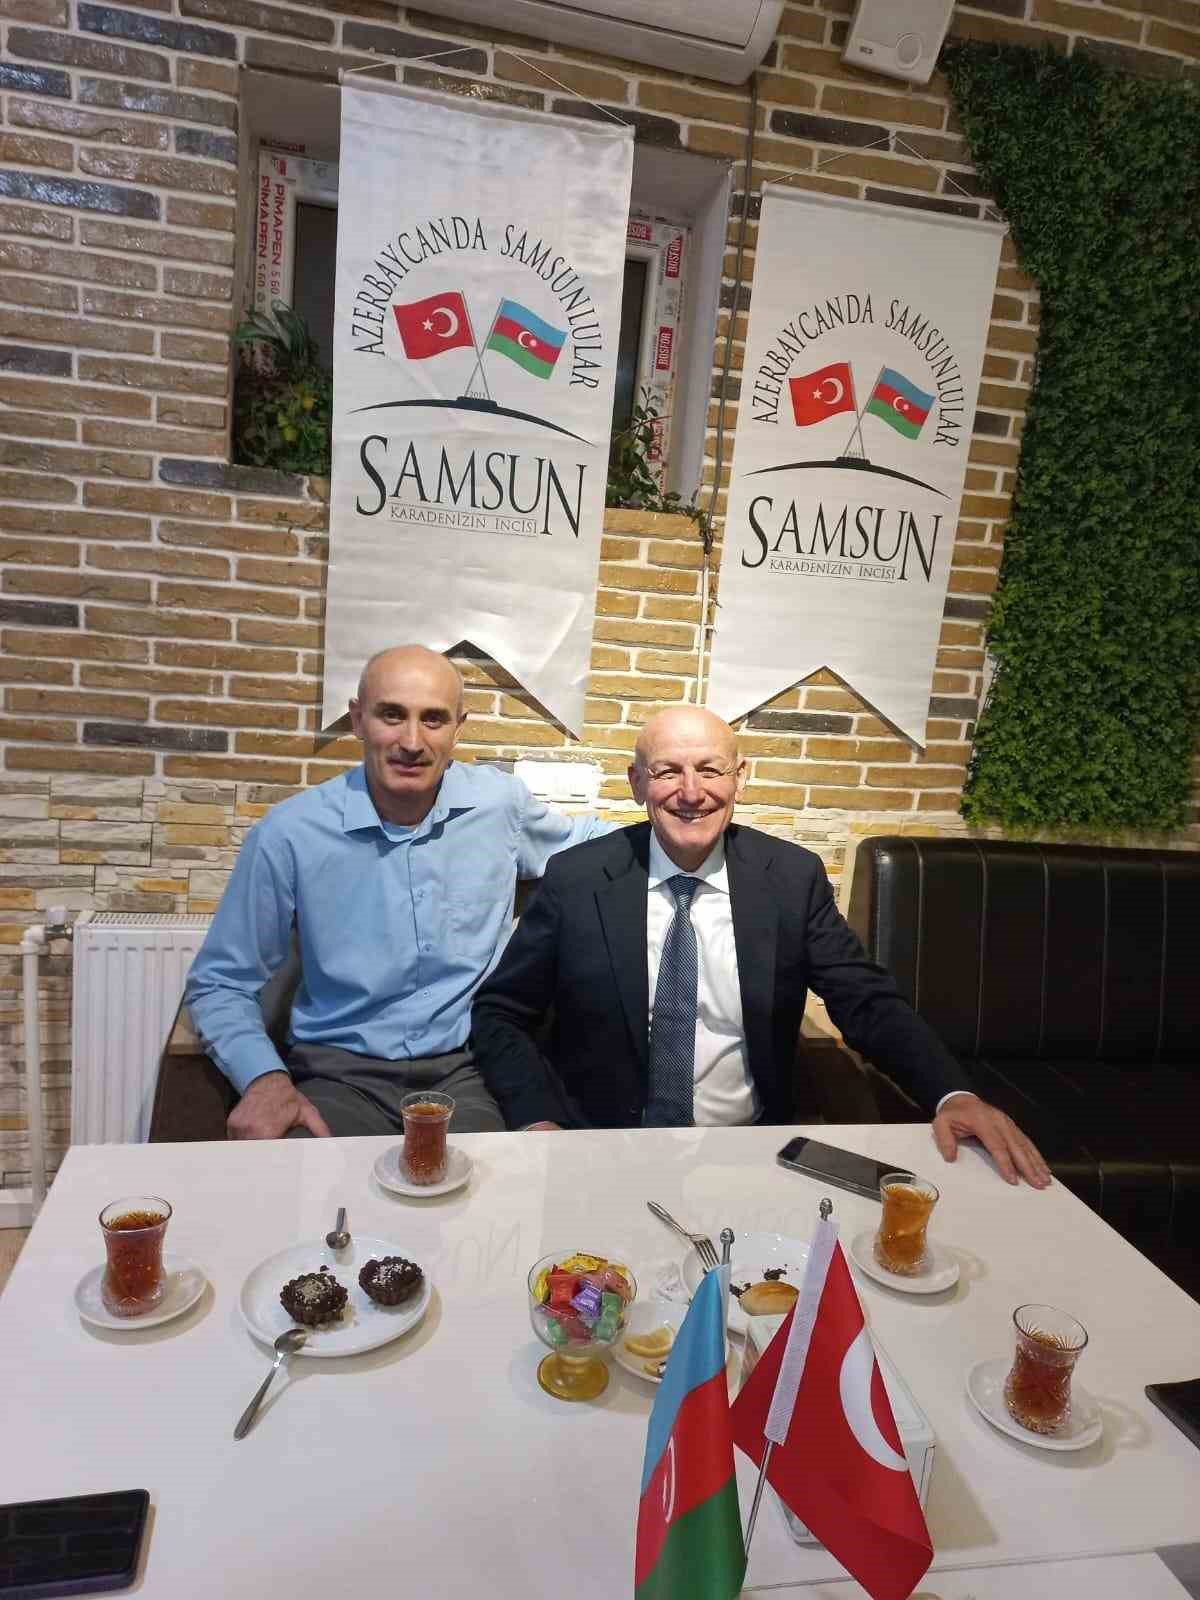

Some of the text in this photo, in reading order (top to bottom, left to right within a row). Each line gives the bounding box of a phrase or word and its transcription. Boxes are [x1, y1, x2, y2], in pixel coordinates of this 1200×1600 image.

[351, 216, 602, 389] AZERBAYCANDA SAMSUNLULAR
[657, 331, 672, 366] BOSFOR
[751, 293, 964, 447] AZERBAYCANDA SAMSUNLULAR
[356, 434, 587, 538] SAMSUN
[741, 495, 943, 583] SAMSUN
